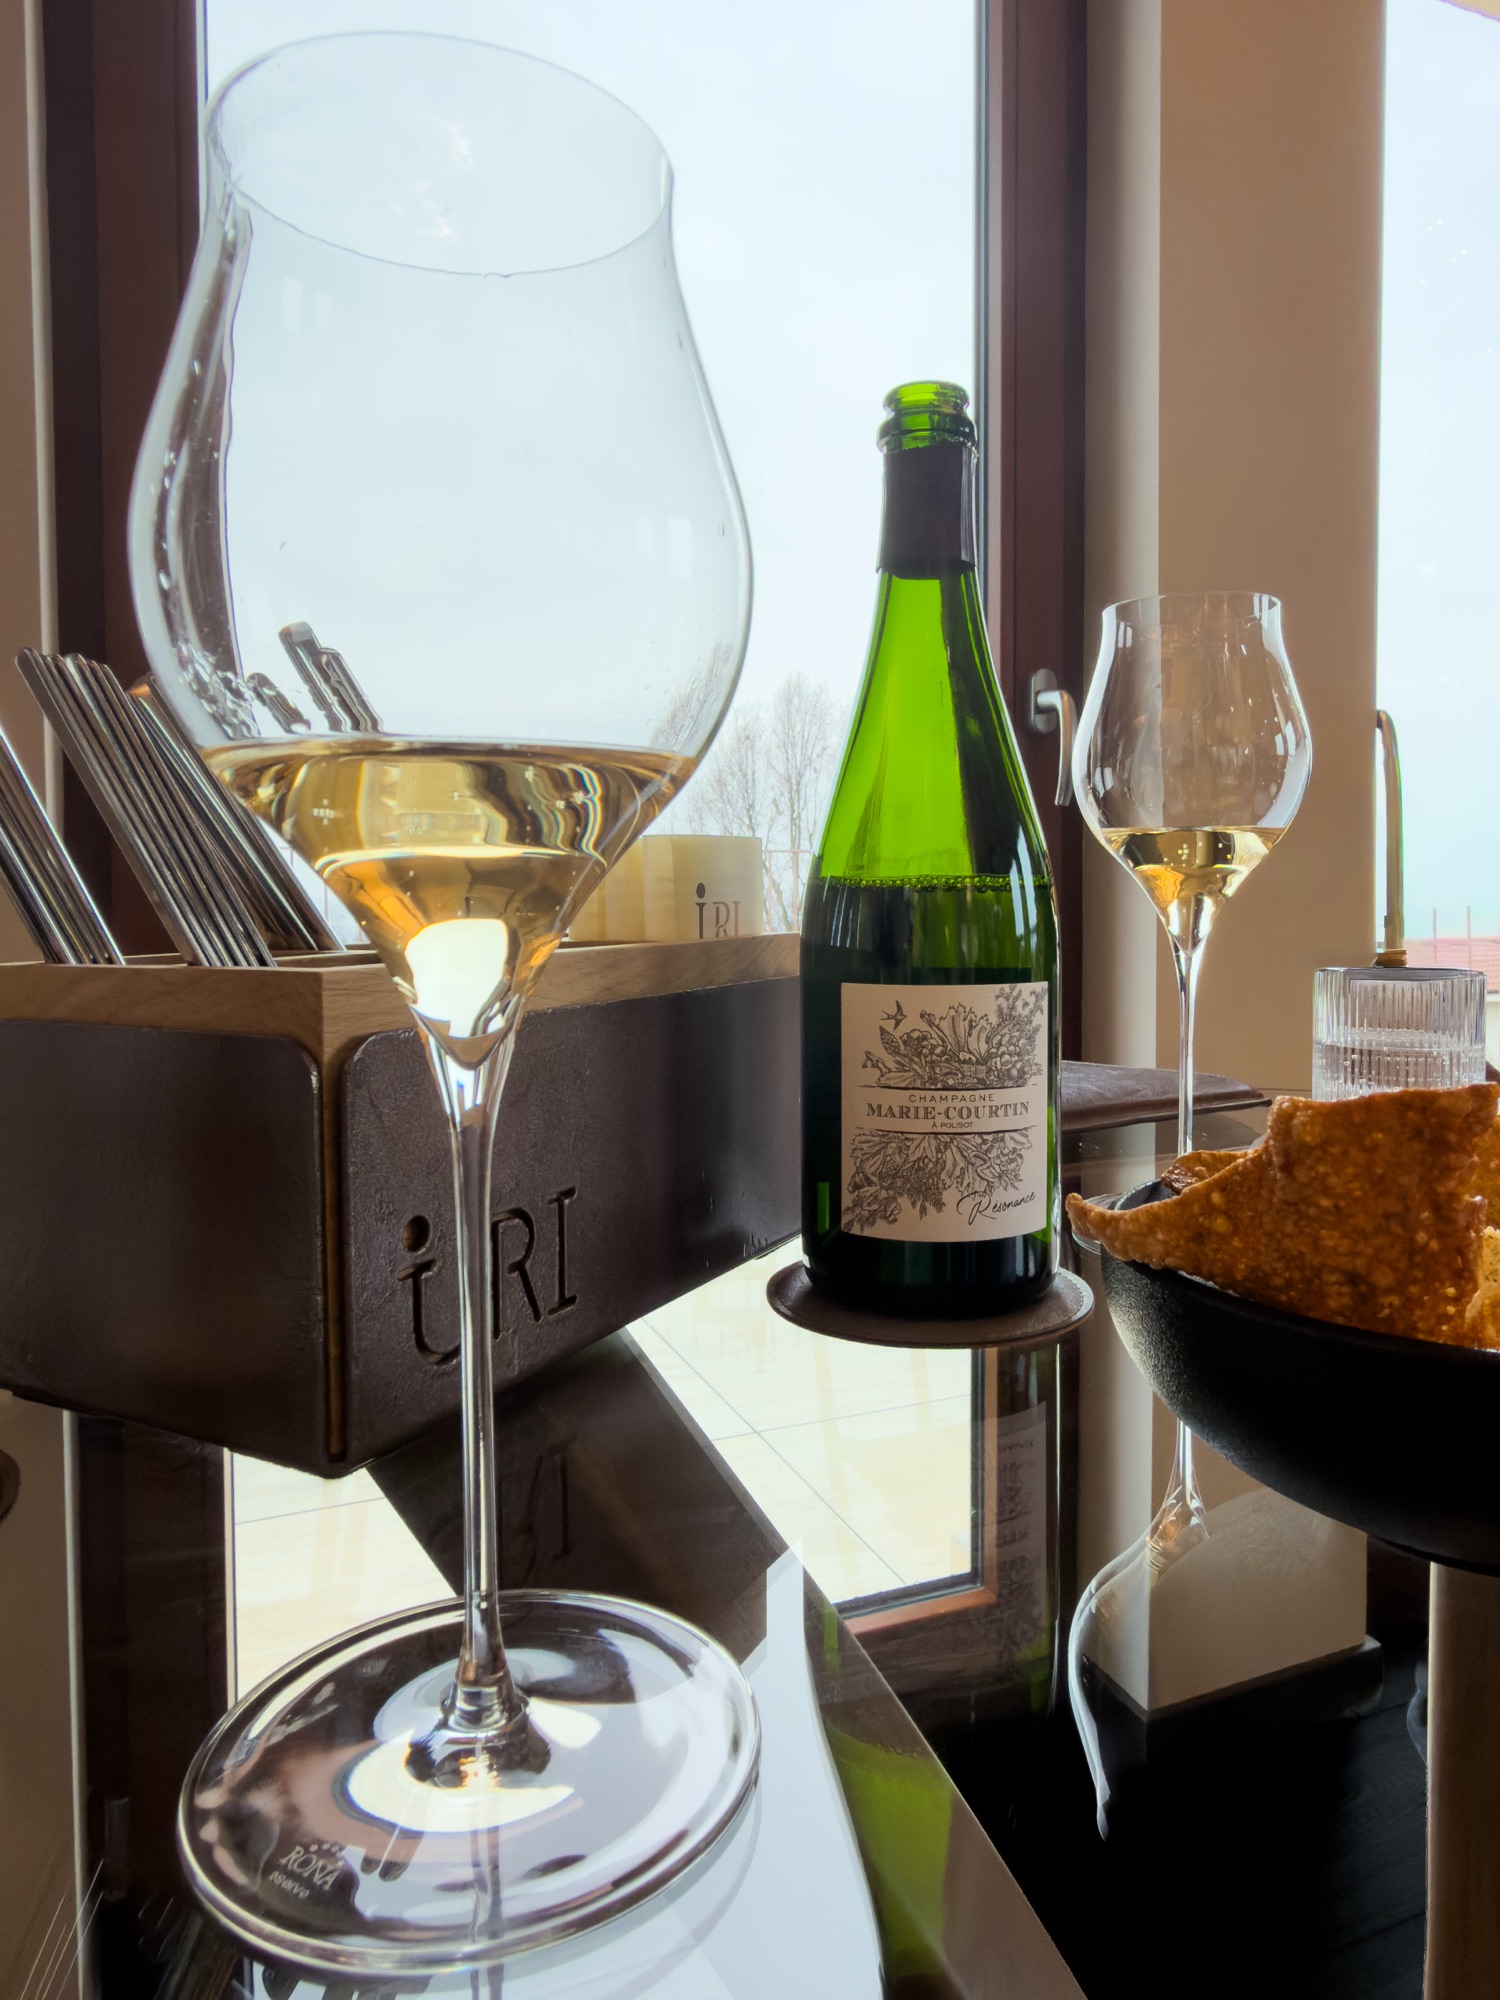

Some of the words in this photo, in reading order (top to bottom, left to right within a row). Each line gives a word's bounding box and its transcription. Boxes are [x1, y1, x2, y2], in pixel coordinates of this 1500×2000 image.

[908, 1093, 995, 1103] CHAMPAGNE
[866, 1101, 1030, 1121] MARIE-COURTIN
[940, 1121, 974, 1129] POLISOT
[279, 1845, 345, 1892] RONA
